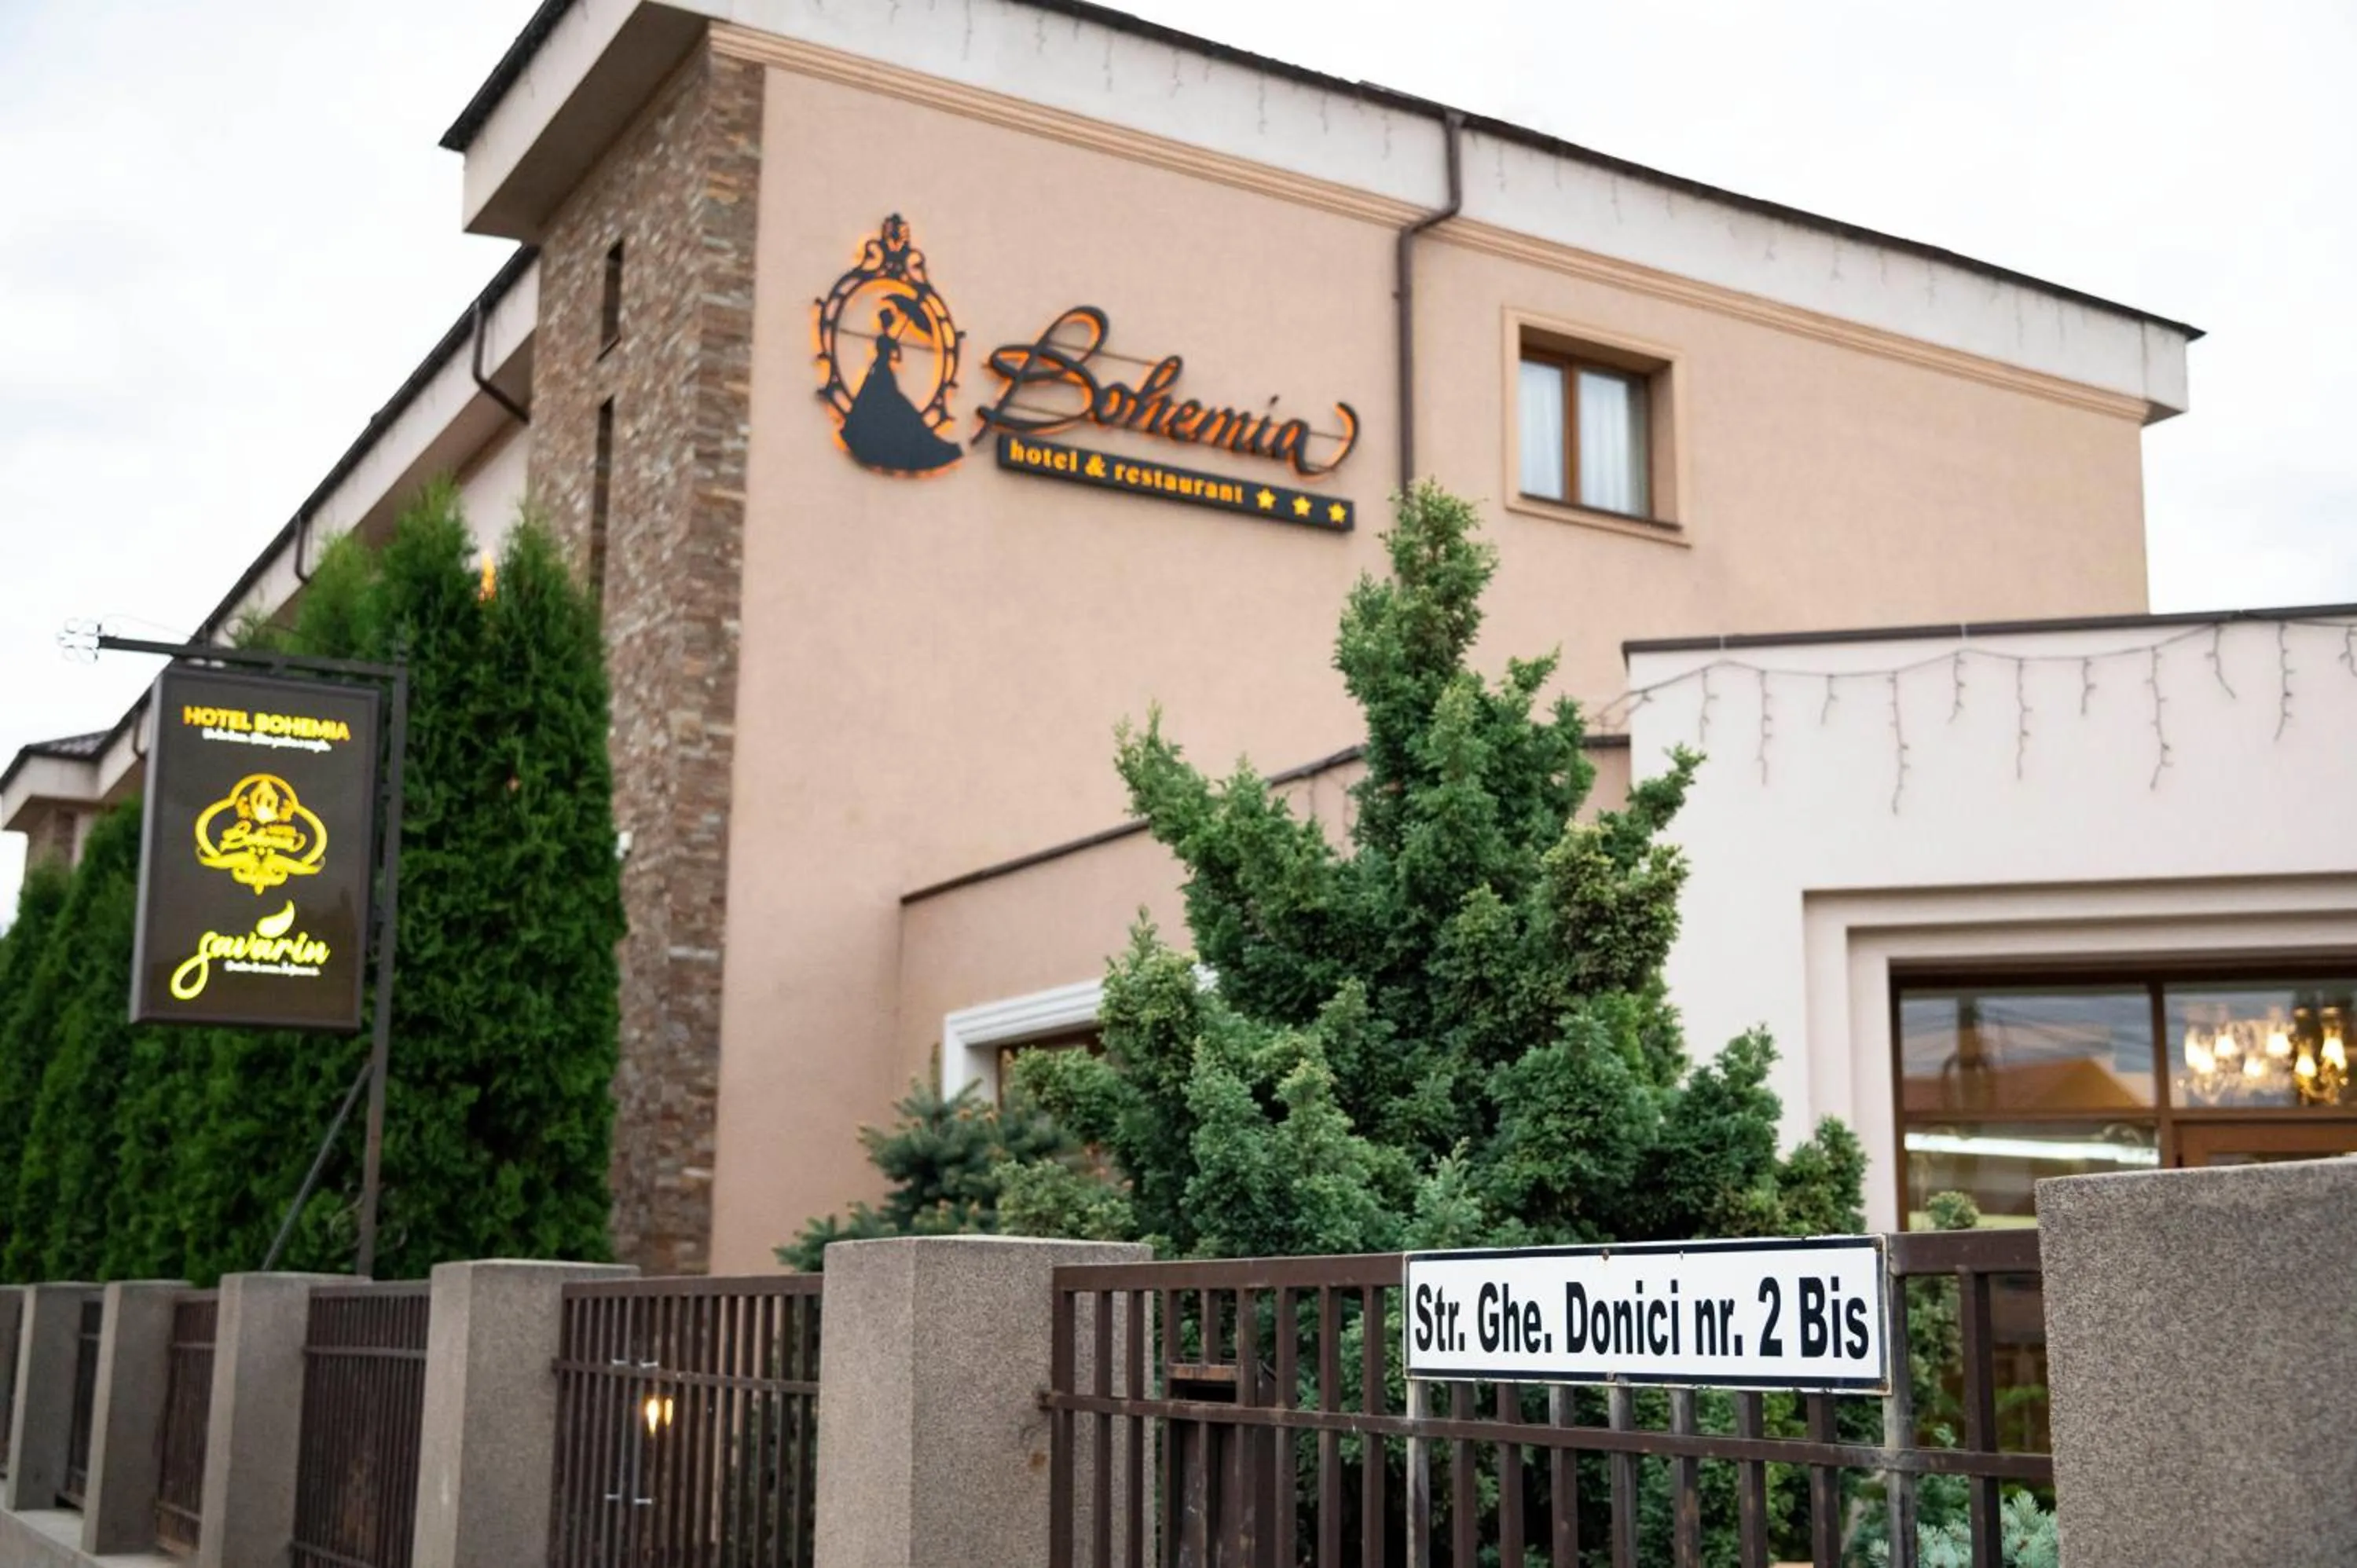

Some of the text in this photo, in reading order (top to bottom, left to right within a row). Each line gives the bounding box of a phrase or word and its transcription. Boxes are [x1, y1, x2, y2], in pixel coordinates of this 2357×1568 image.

[970, 306, 1360, 477] Bohemia
[1009, 439, 1244, 504] hotel & restaurant
[183, 705, 252, 731] HOTEL
[254, 712, 350, 741] BOHEMIA
[1415, 1276, 1869, 1360] Str. Ghe. Donici nr. 2 Bis
